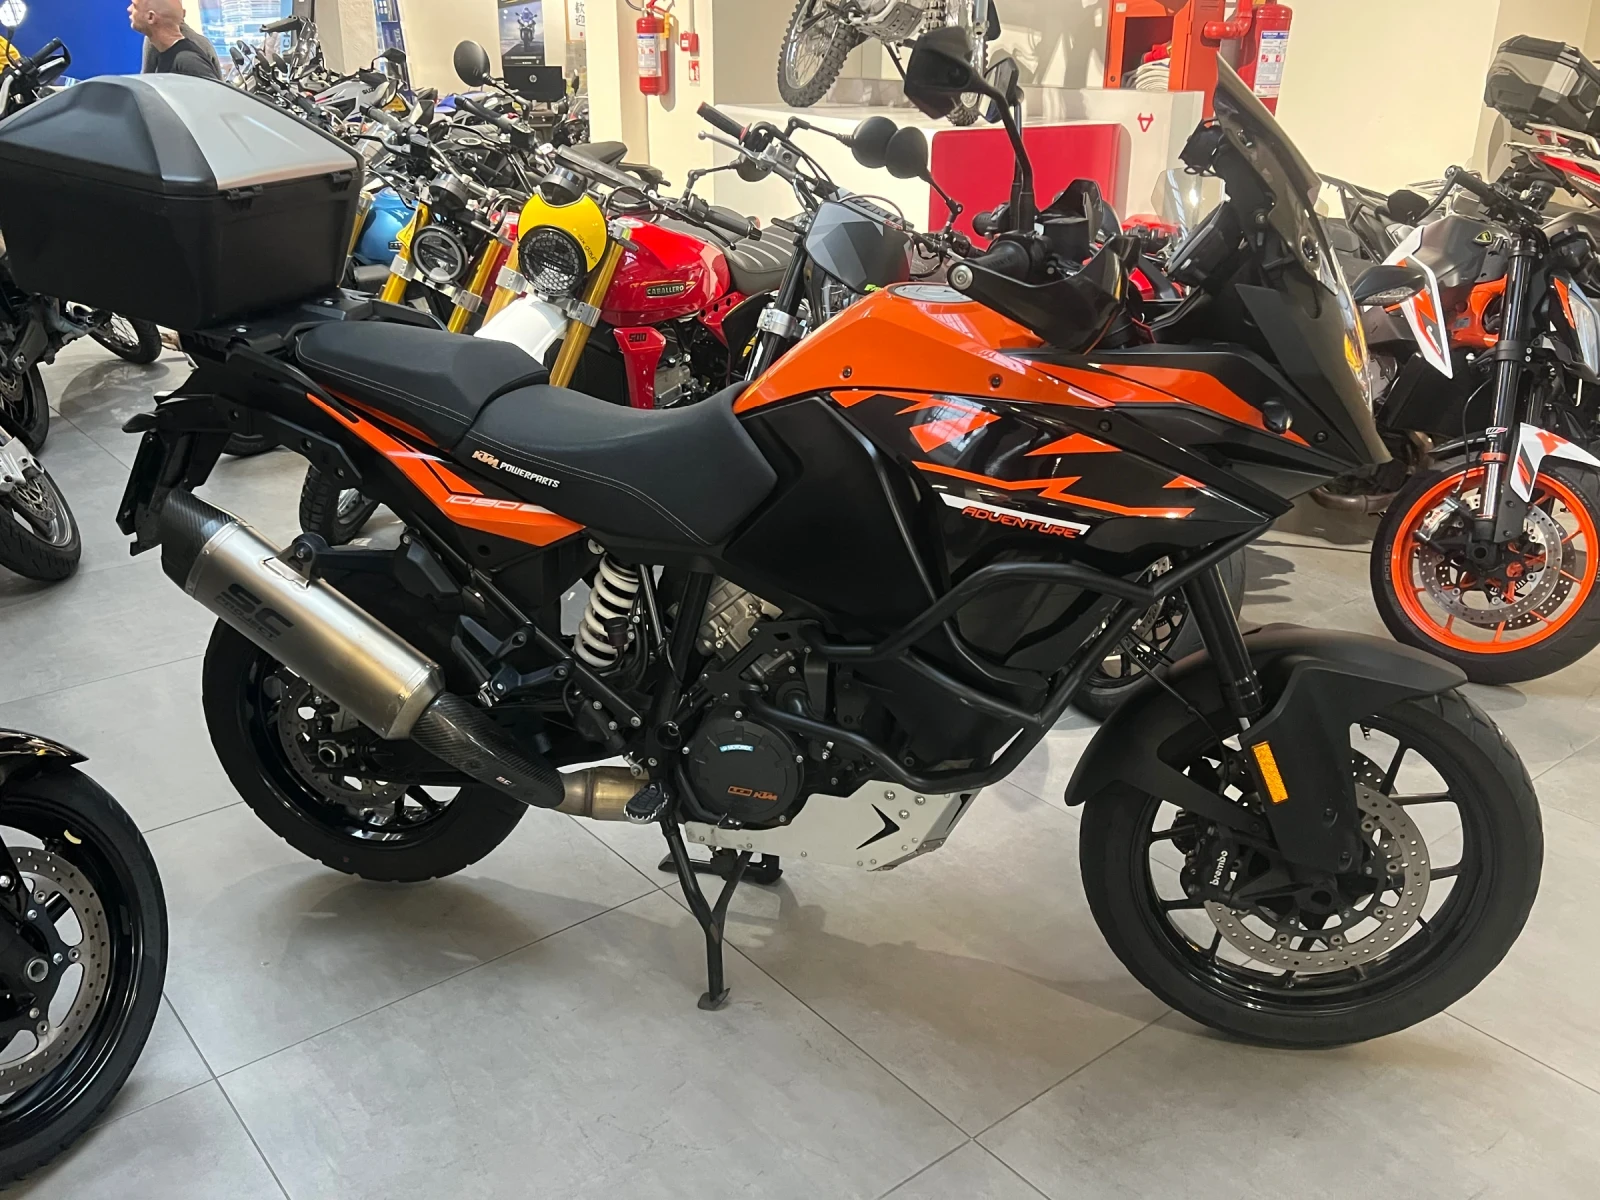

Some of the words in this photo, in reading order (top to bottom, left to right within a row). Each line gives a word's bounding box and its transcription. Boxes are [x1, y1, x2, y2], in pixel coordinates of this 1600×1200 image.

[647, 285, 685, 295] CABALLERO
[472, 450, 500, 470] KTM
[500, 461, 560, 488] POWERPARTS
[446, 495, 521, 510] 1090
[962, 506, 1081, 538] ADVENTURE
[221, 583, 295, 636] SC
[753, 791, 778, 800] KTM
[1209, 850, 1228, 886] brembo
